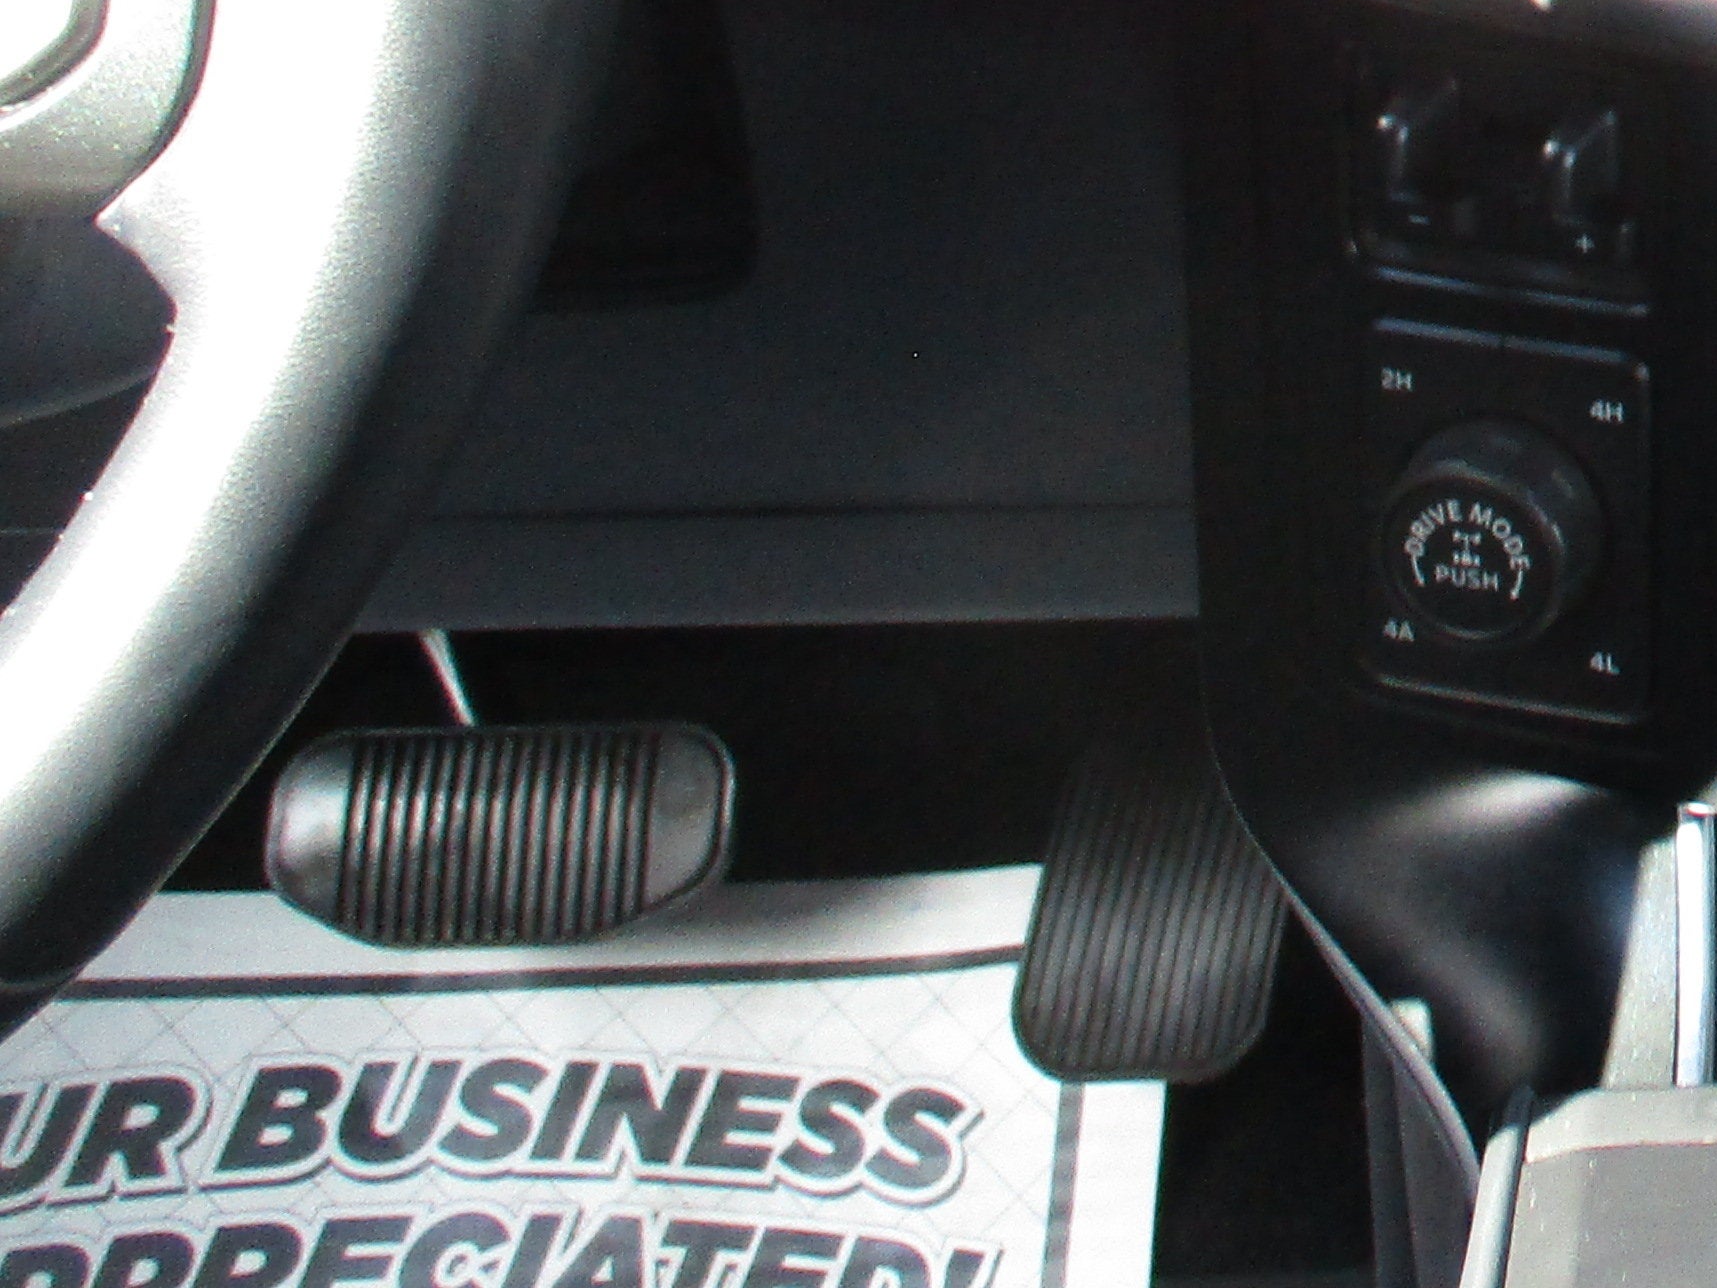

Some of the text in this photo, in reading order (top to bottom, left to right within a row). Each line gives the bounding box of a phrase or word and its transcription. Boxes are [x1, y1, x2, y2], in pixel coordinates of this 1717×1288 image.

[1381, 367, 1413, 392] 2H
[1589, 399, 1624, 423] 4H
[1404, 498, 1532, 571] DRIVE MODE
[1434, 564, 1500, 592] PUSH
[1383, 616, 1416, 642] 4A
[1589, 652, 1621, 676] 4L
[212, 1056, 968, 1192] BUSINESS
